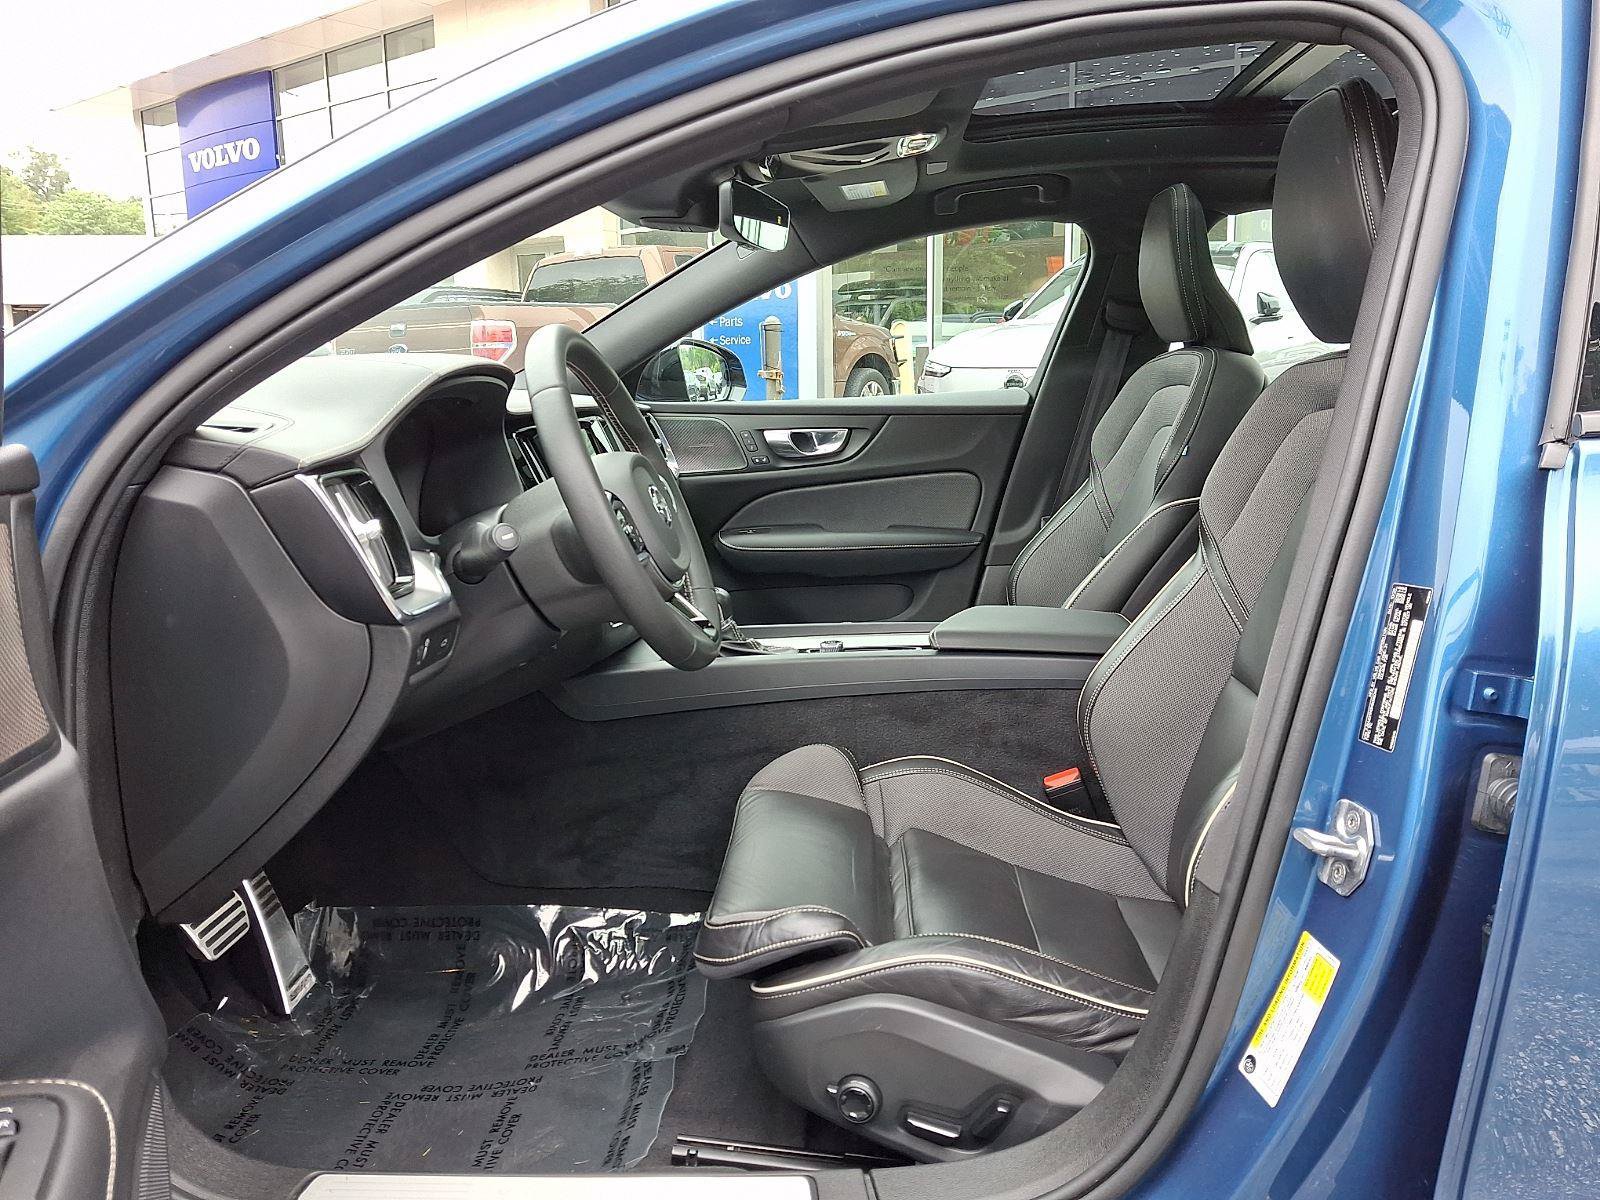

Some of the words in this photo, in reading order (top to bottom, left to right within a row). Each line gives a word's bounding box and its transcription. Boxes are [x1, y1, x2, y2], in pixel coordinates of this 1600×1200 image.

[188, 136, 261, 173] VOLVO
[720, 316, 743, 327] Parts
[720, 335, 752, 346] Service
[1282, 942, 1305, 986] INFORMATION
[414, 1033, 439, 1060] DEALER
[530, 1047, 577, 1063] DEALER
[583, 1044, 622, 1056] MUST
[202, 1054, 237, 1079] MUST
[280, 1063, 355, 1075] PROTECTIVE
[359, 1068, 401, 1077] COVER
[288, 1055, 336, 1066] DEALER
[343, 1059, 377, 1068] MUST
[382, 1059, 436, 1069] REMOVE
[524, 1055, 599, 1071] PROTECTIVE
[240, 1078, 288, 1096] DEALER
[420, 1084, 463, 1093] COVER
[467, 1076, 543, 1093] PROTECTIVE
[490, 1085, 538, 1099] DEALER
[385, 1092, 440, 1102] REMOVE
[445, 1093, 484, 1102] MUST
[376, 1101, 407, 1134] DEALER
[228, 1113, 262, 1143] COVER
[344, 1099, 392, 1156] PROTECTIVE
[471, 1139, 495, 1168] MUST
[488, 1096, 518, 1134] REMOVE
[498, 1113, 523, 1145] COVER
[352, 1139, 380, 1169] MUST
